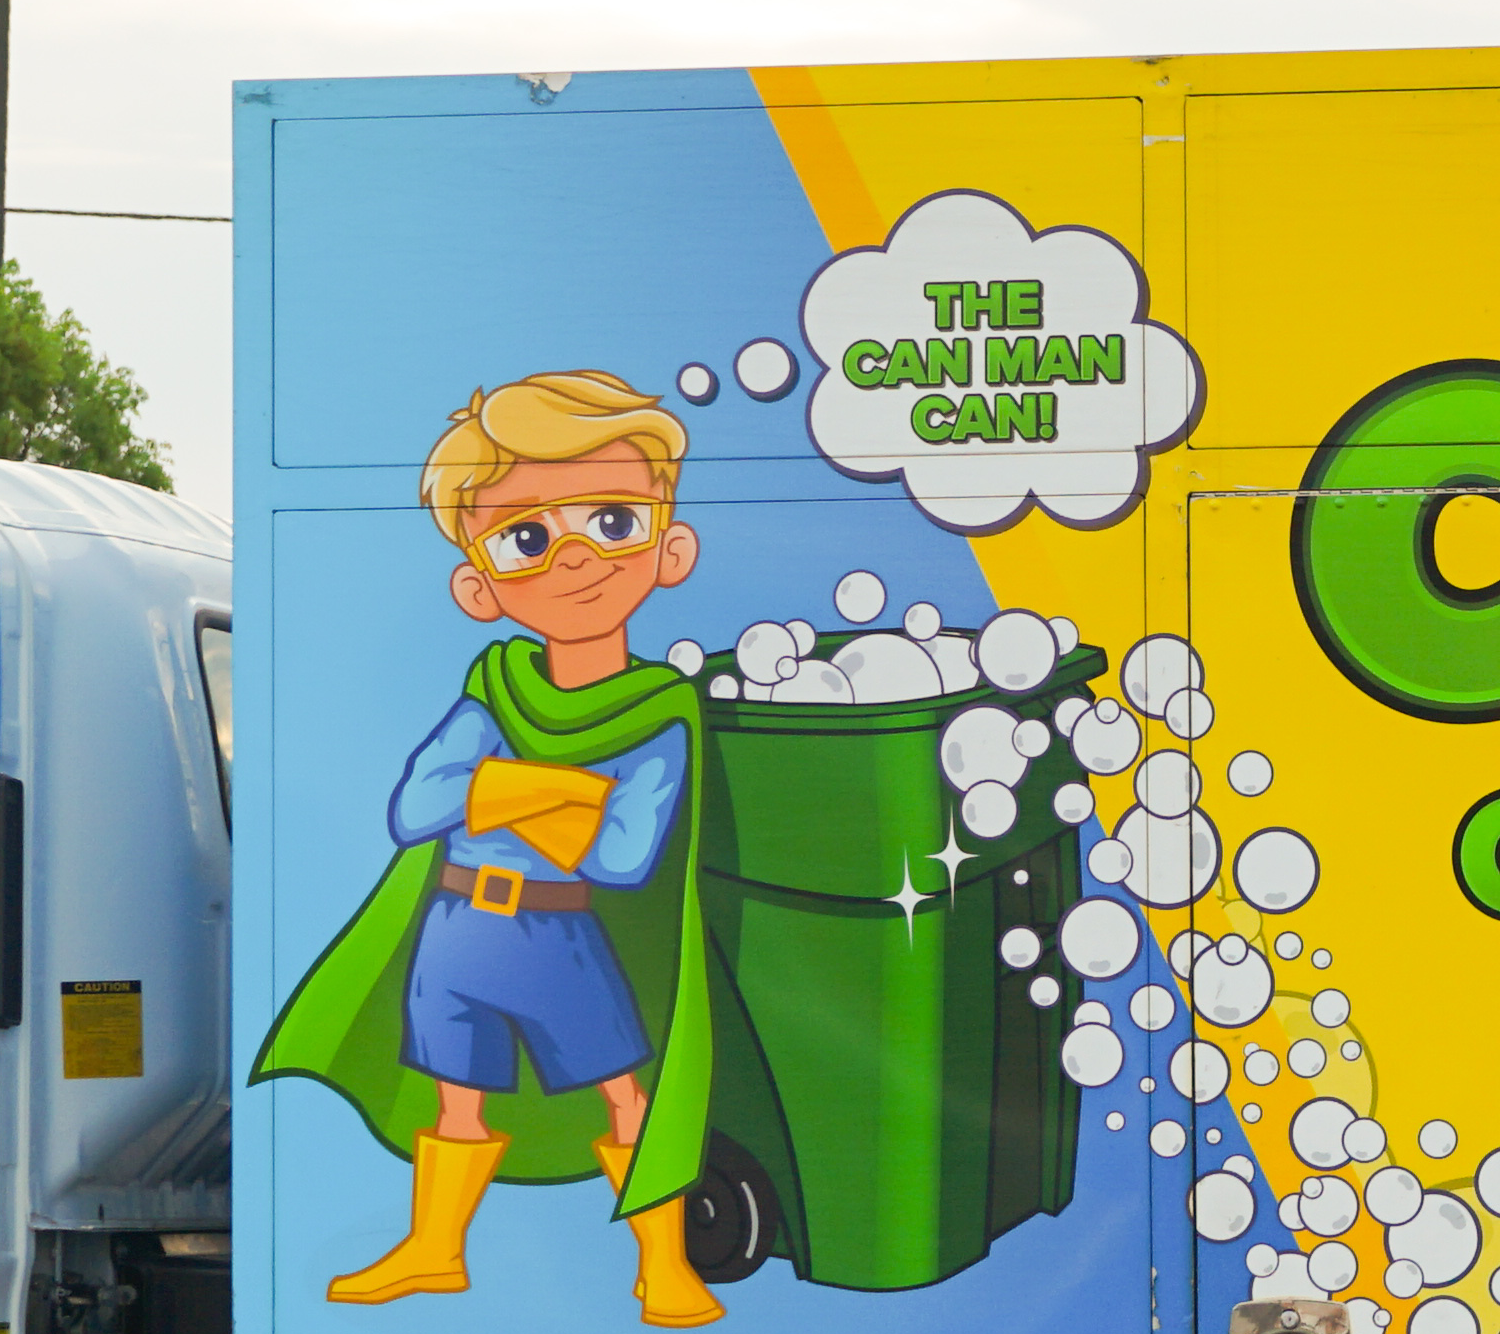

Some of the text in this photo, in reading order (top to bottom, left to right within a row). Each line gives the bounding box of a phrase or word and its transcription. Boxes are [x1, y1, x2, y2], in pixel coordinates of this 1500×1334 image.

[924, 279, 1043, 331] THE
[842, 333, 1125, 388] CAN MAN
[910, 391, 1059, 444] CAN!
[73, 982, 131, 993] CAUTION
